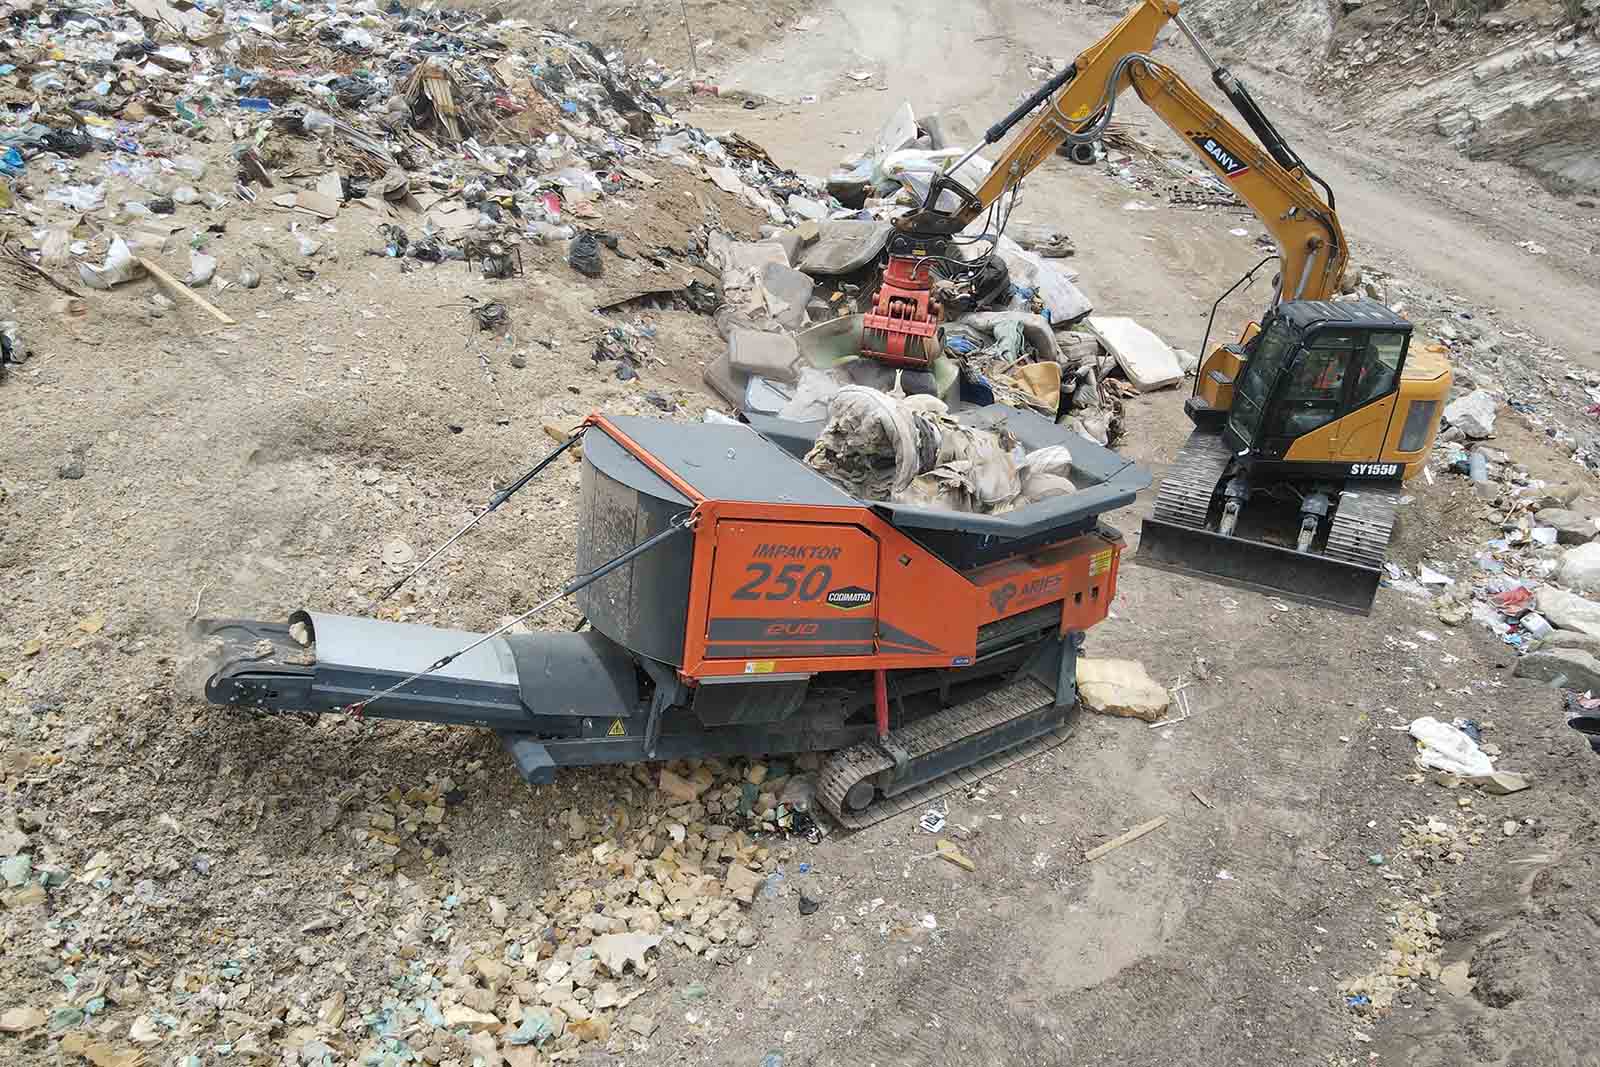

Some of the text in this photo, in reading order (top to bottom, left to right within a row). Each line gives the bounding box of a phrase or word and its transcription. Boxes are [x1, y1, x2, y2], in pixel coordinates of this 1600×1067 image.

[1204, 139, 1238, 171] SANY
[1351, 464, 1397, 475] SY155U
[753, 543, 842, 561] IMPAKTOR
[732, 563, 832, 601] 250
[828, 592, 871, 602] CODIMATRA
